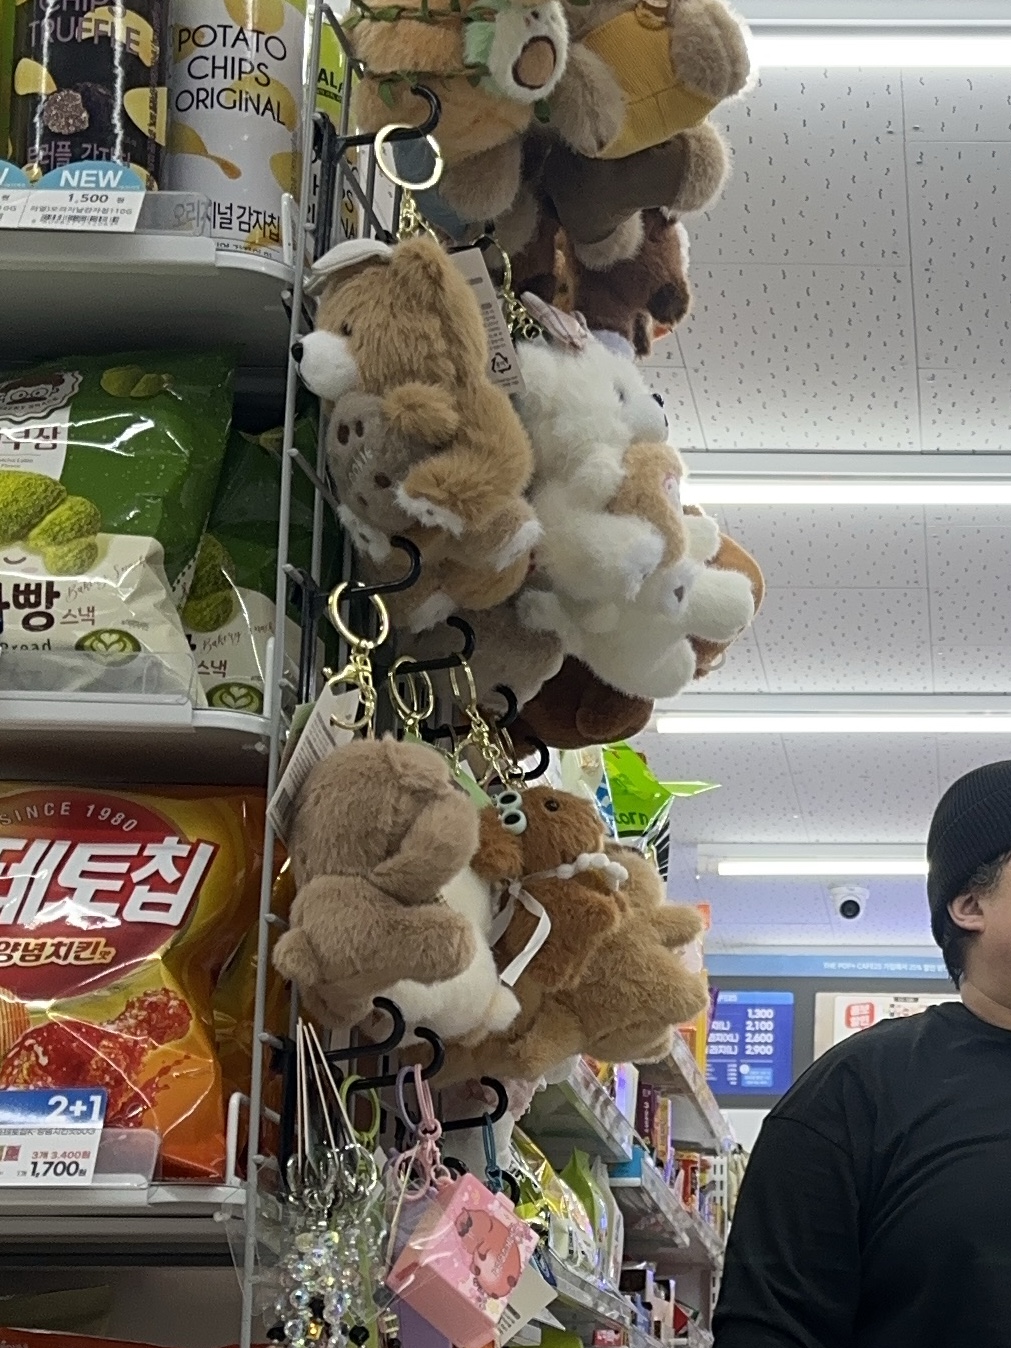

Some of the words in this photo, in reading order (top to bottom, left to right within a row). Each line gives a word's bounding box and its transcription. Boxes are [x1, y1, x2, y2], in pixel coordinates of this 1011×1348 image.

[178, 24, 287, 61] POTATO
[187, 55, 271, 87] CHIPS
[175, 87, 286, 126] ORIGINAL
[59, 169, 124, 188] NEW
[236, 205, 281, 242] 감자칩
[60, 605, 95, 627] 스낵
[197, 659, 228, 678] 스낵
[0, 801, 71, 826] SINCE
[86, 803, 139, 832] 1980
[45, 1094, 102, 1121] 2+1
